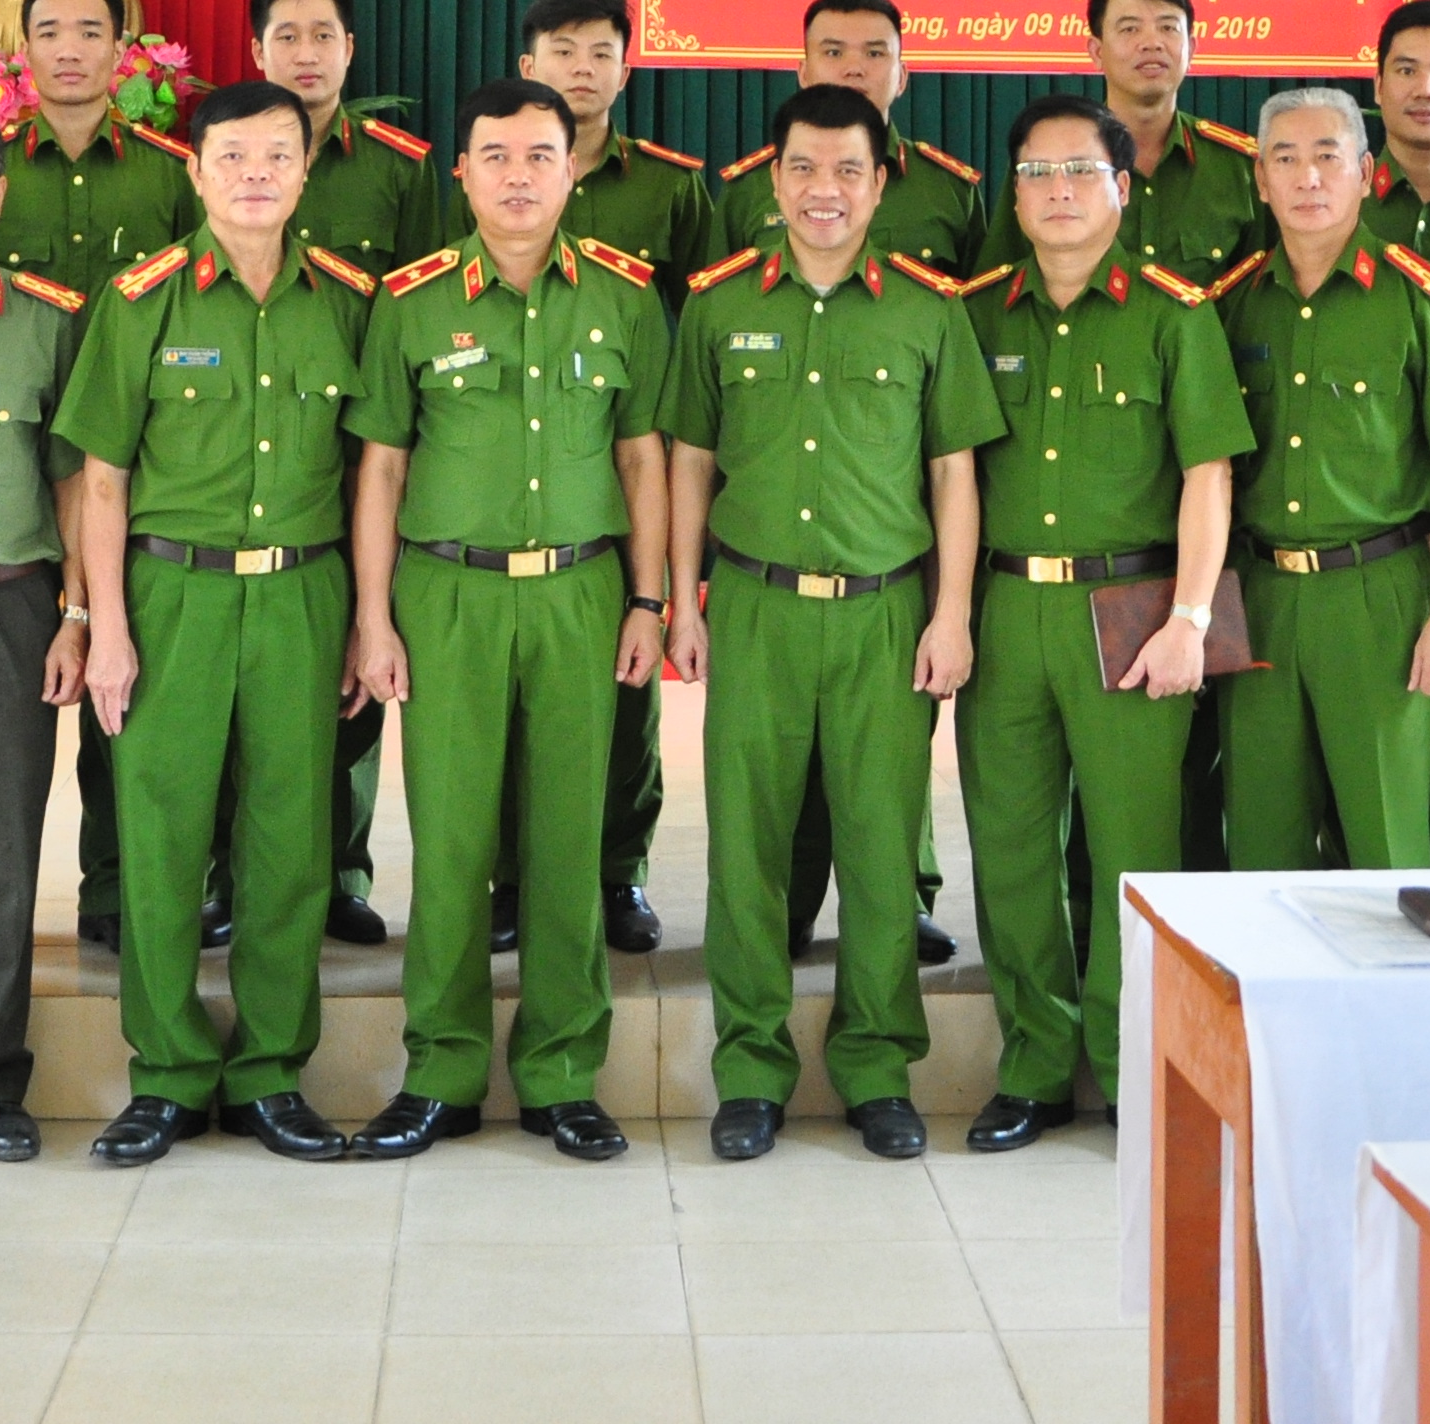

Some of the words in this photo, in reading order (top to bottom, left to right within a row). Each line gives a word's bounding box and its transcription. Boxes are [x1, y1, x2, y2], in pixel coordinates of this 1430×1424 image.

[901, 11, 948, 40] òng,
[957, 12, 1018, 41] ngày
[1024, 13, 1053, 36] 09
[1213, 16, 1271, 39] 2019
